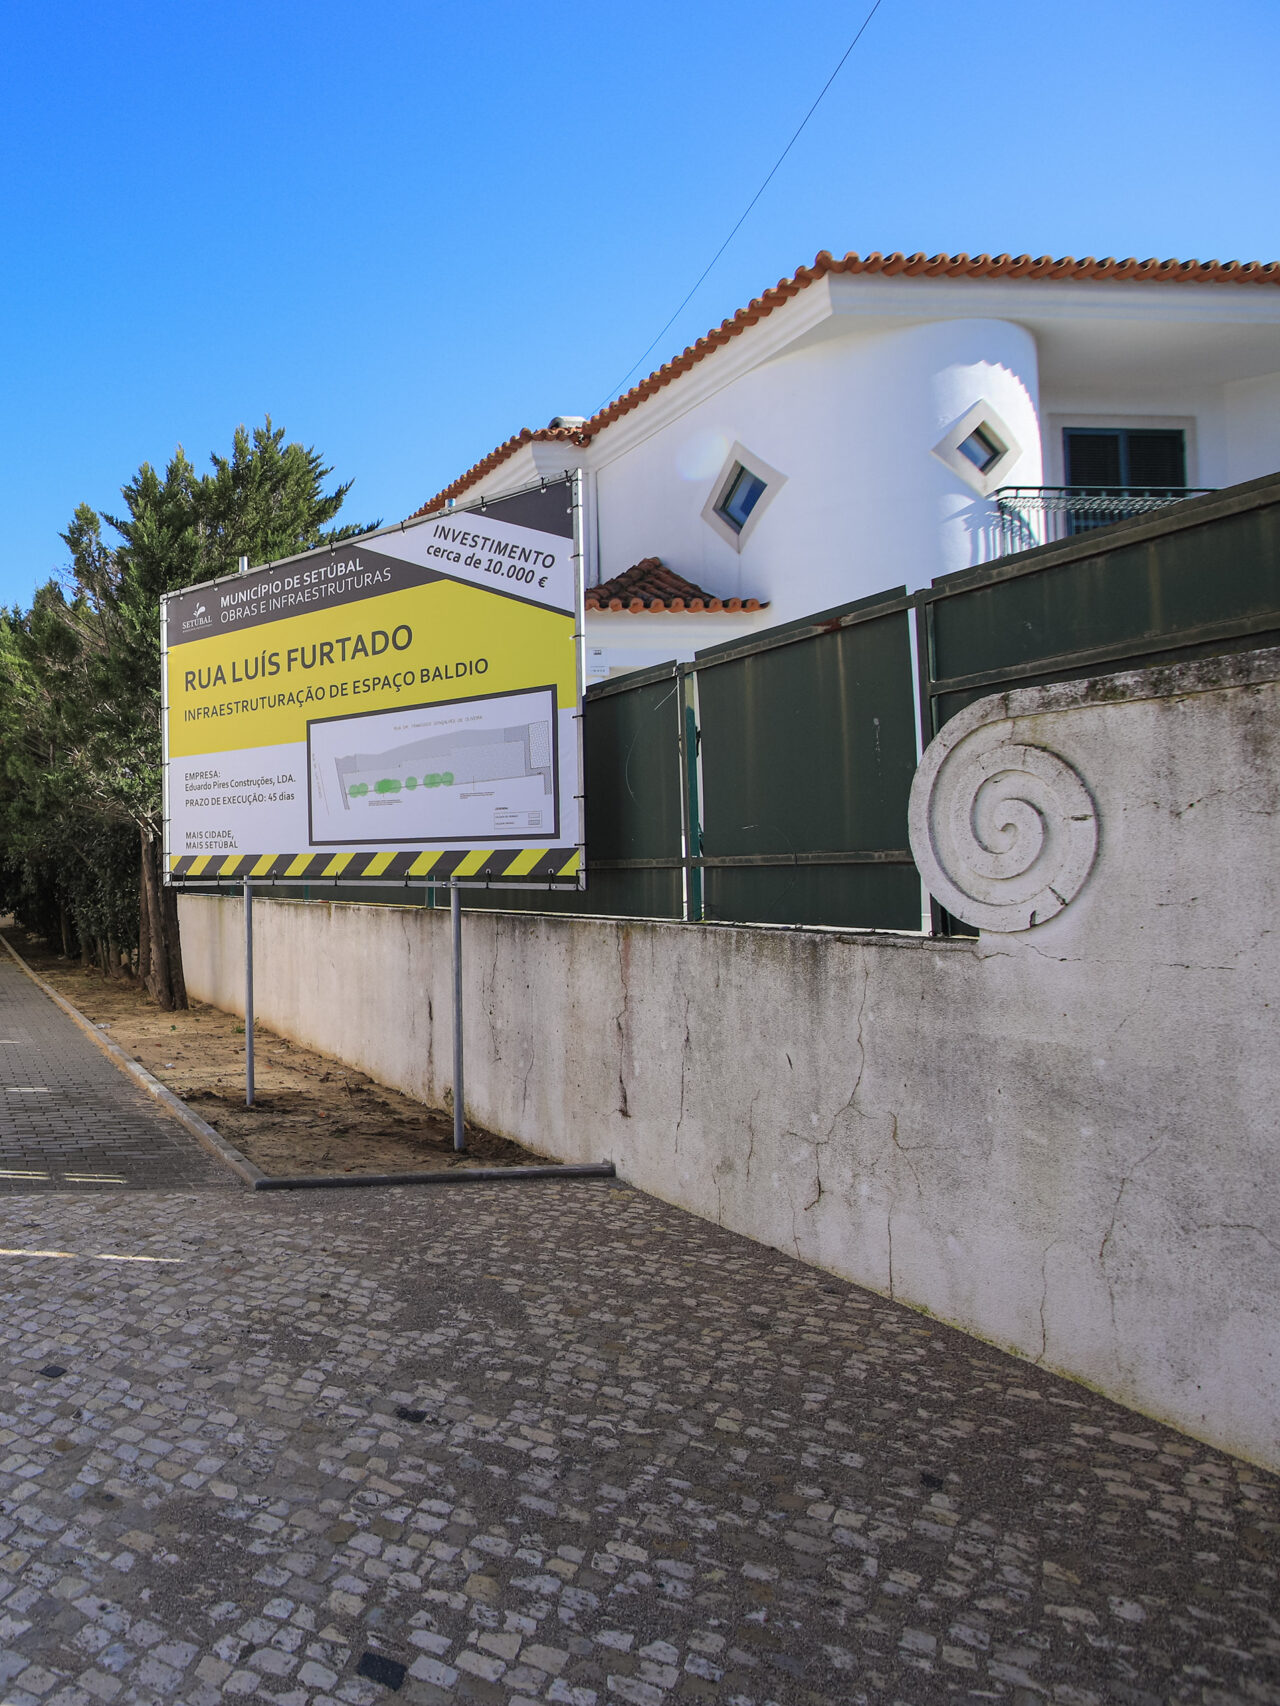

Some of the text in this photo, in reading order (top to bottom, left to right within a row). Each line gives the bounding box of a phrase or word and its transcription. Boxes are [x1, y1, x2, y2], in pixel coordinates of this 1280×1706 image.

[426, 544, 548, 588] cerca de 10.000 €
[433, 524, 556, 569] INVESTIMENTO
[220, 557, 364, 608] MUNICÍPIO DE SETÚBAL
[220, 567, 392, 624] OBRAS E INFRAESTRUTURAS
[184, 624, 413, 692] RUA LUÍS FURTADO
[184, 658, 489, 722] INFRAESTRUTURAÇÃO DE ESPAÇO BALDIO
[184, 770, 221, 781] EMPRESA:
[185, 774, 296, 792] Eduardo Pires Construções, LDA.
[185, 791, 295, 807] PRAZO DE EXECUÇÃO: 45 dias
[185, 830, 234, 840] MAIS CIDADE,
[185, 840, 239, 850] MAIS SETÚBAL
